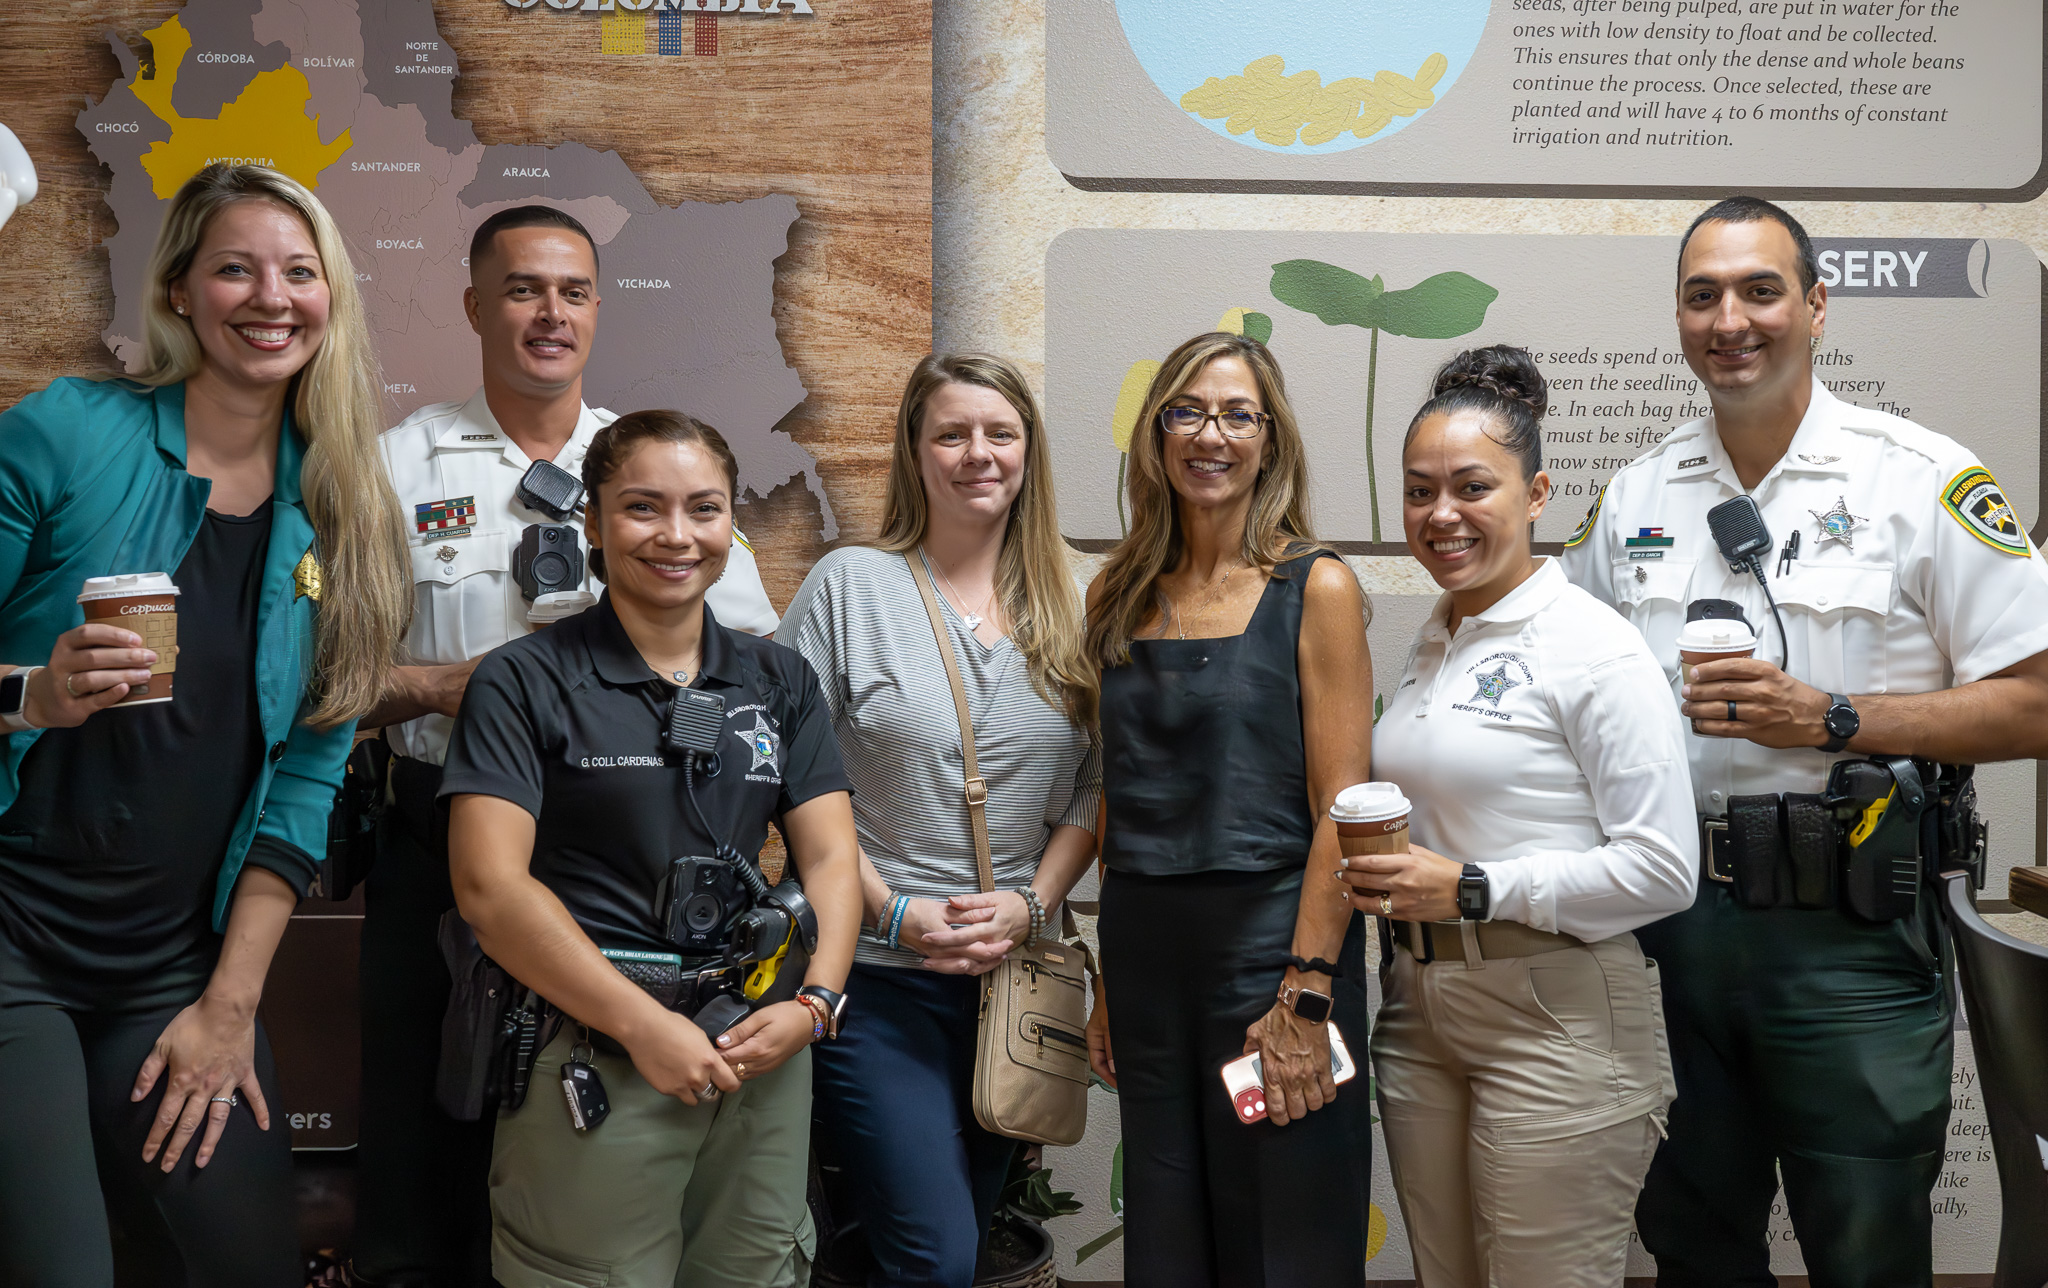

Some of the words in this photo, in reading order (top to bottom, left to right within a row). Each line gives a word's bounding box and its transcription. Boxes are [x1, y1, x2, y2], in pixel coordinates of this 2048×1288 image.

[1512, 0, 1566, 13] seeds,
[1573, 0, 1616, 17] after
[1622, 0, 1671, 18] being
[1676, 0, 1742, 18] pulped,
[1749, 1, 1778, 15] are
[1782, 0, 1814, 19] put
[1819, 0, 1837, 15] in
[1843, 0, 1894, 16] water
[1894, 0, 1925, 21] for
[1930, 0, 1960, 17] the
[1513, 24, 1555, 38] ones
[1561, 21, 1600, 39] with
[1606, 21, 1638, 39] low
[1644, 22, 1711, 45] density
[1716, 26, 1734, 41] to
[1736, 23, 1782, 46] float
[1787, 24, 1822, 42] and
[1827, 24, 1848, 42] be
[1852, 25, 1937, 43] collected.
[406, 42, 438, 51] NORTE
[196, 52, 255, 64] CÓRDOBA
[303, 55, 355, 68] BOLÍVAR
[416, 54, 429, 62] DE
[1514, 47, 1553, 65] This
[1558, 51, 1629, 66] ensures
[1634, 49, 1672, 66] that
[1677, 49, 1717, 72] only
[1722, 49, 1752, 67] the
[1756, 50, 1808, 68] dense
[1813, 51, 1848, 69] and
[1853, 52, 1907, 69] whole
[1912, 52, 1965, 70] beans
[395, 65, 453, 74] SANTANDER
[1513, 74, 1594, 92] continue
[1599, 75, 1628, 92] the
[1632, 79, 1706, 97] process.
[1713, 76, 1761, 94] Once
[1766, 77, 1843, 97] selected,
[1850, 78, 1897, 95] these
[1902, 82, 1932, 96] are
[1511, 100, 1582, 121] planted
[1587, 101, 1622, 119] and
[1626, 101, 1659, 119] will
[1665, 102, 1707, 120] have
[1712, 106, 1723, 124] 4
[1729, 105, 1747, 120] to
[1753, 103, 1765, 120] 6
[1770, 104, 1840, 121] months
[1845, 104, 1867, 126] of
[1868, 107, 1949, 122] constant
[95, 121, 139, 133] CHOCÓ
[1512, 127, 1600, 149] irrigation
[1606, 128, 1641, 145] and
[1646, 129, 1733, 146] nutrition.
[351, 162, 421, 173] SANTANDER
[502, 167, 551, 178] ARAUCA
[375, 236, 424, 250] BOYACÁ
[1817, 250, 1928, 288] SERY
[616, 278, 671, 290] VICHADA
[1549, 347, 1598, 364] seeds
[1603, 347, 1658, 369] spend
[1813, 349, 1854, 366] nths
[384, 383, 416, 394] META
[1590, 373, 1619, 391] the
[1623, 374, 1698, 396] seedling
[1568, 400, 1587, 417] In
[1592, 400, 1634, 417] each
[1641, 400, 1673, 422] bag
[1546, 429, 1594, 444] must
[1599, 426, 1620, 444] be
[1549, 457, 1587, 470] now
[1565, 482, 1583, 496] to
[1484, 710, 1513, 722] OFFICE
[591, 756, 616, 767] COLL
[617, 756, 665, 767] CARDENAS
[1944, 1150, 1972, 1162] ere
[1976, 1146, 1991, 1162] is
[1932, 1197, 1968, 1219] ally,
